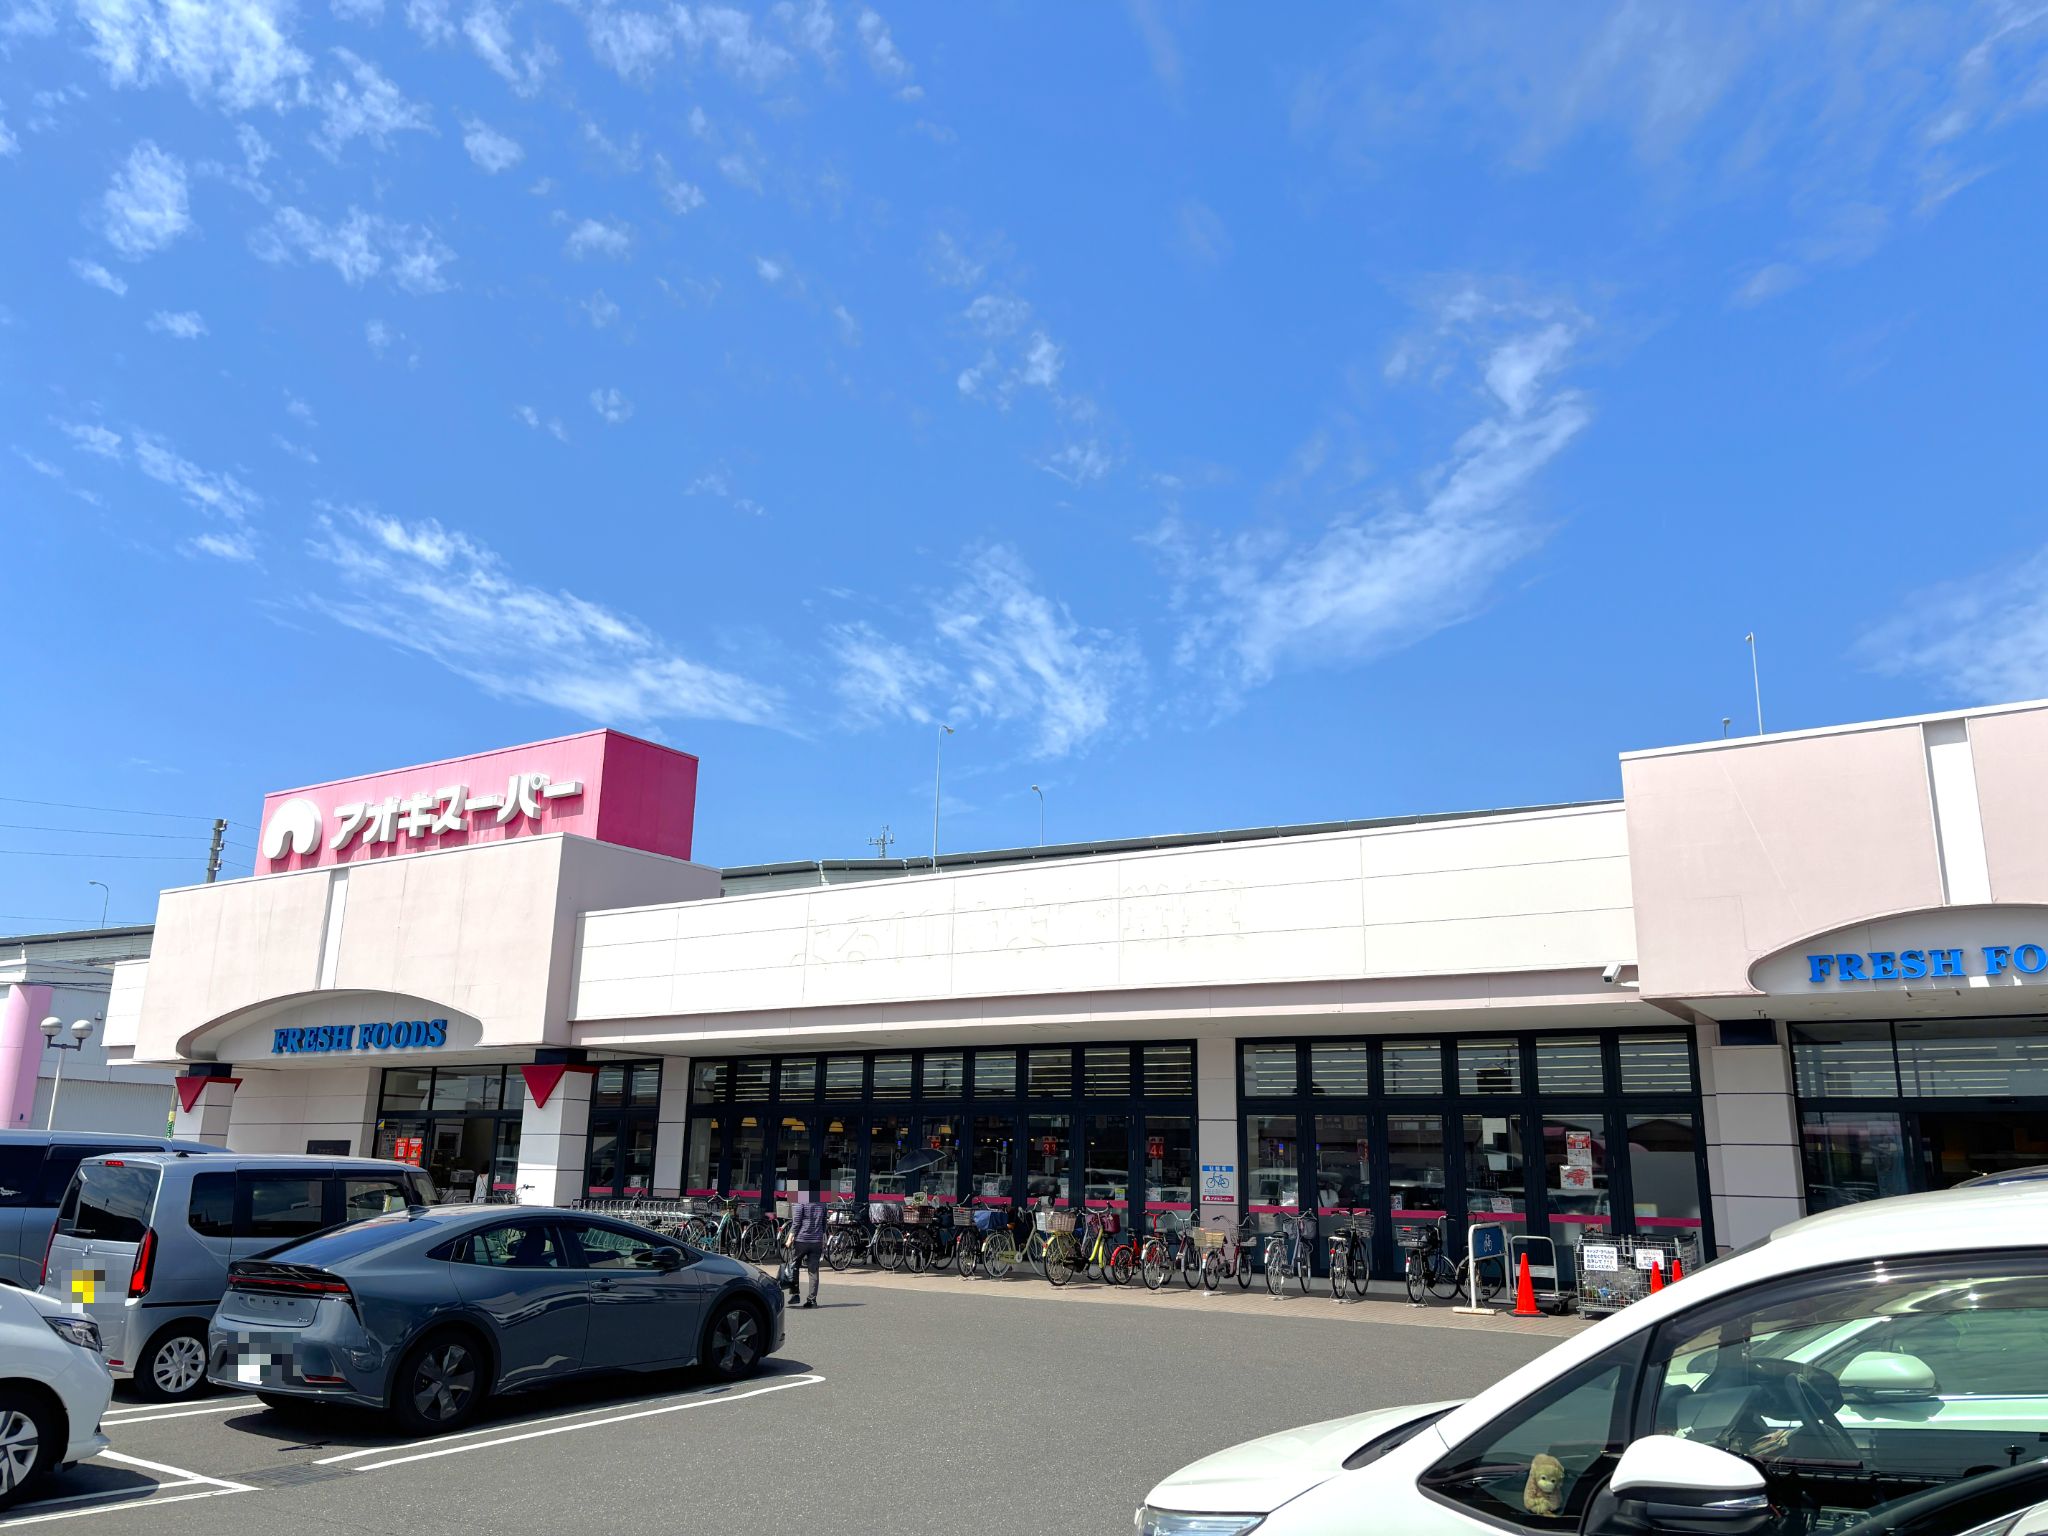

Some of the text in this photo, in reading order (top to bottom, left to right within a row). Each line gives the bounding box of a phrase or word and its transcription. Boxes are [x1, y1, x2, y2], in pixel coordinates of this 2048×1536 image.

[329, 773, 584, 850] アオキスーパー
[1806, 948, 1967, 983] FRESH
[272, 1019, 448, 1053] FRESH FOODS
